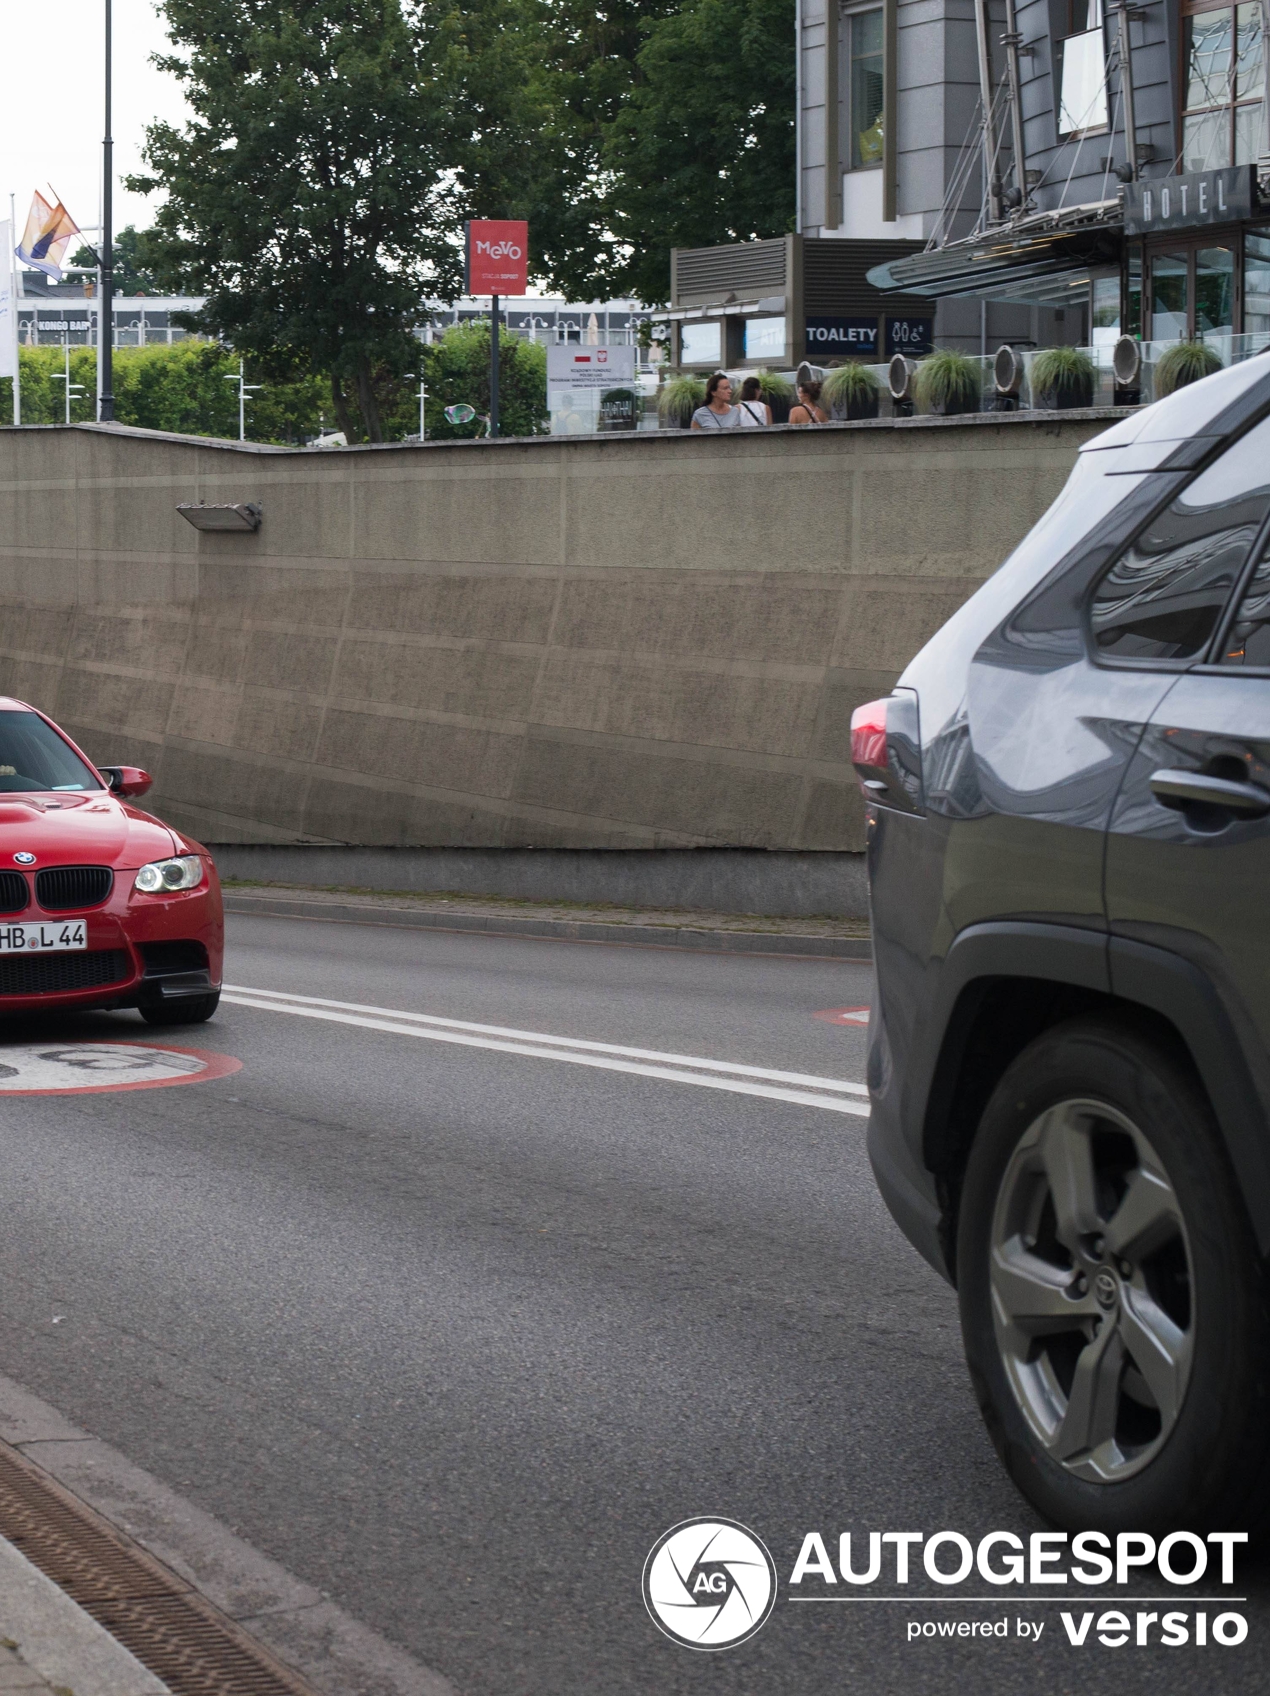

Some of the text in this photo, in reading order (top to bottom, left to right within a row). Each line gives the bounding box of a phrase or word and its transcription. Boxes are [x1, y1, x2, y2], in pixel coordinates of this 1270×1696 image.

[1143, 179, 1227, 222] HOTEL
[39, 321, 88, 330] KONGO BAR
[806, 327, 878, 342] TOALETY
[40, 926, 54, 947] L
[59, 924, 84, 946] 44
